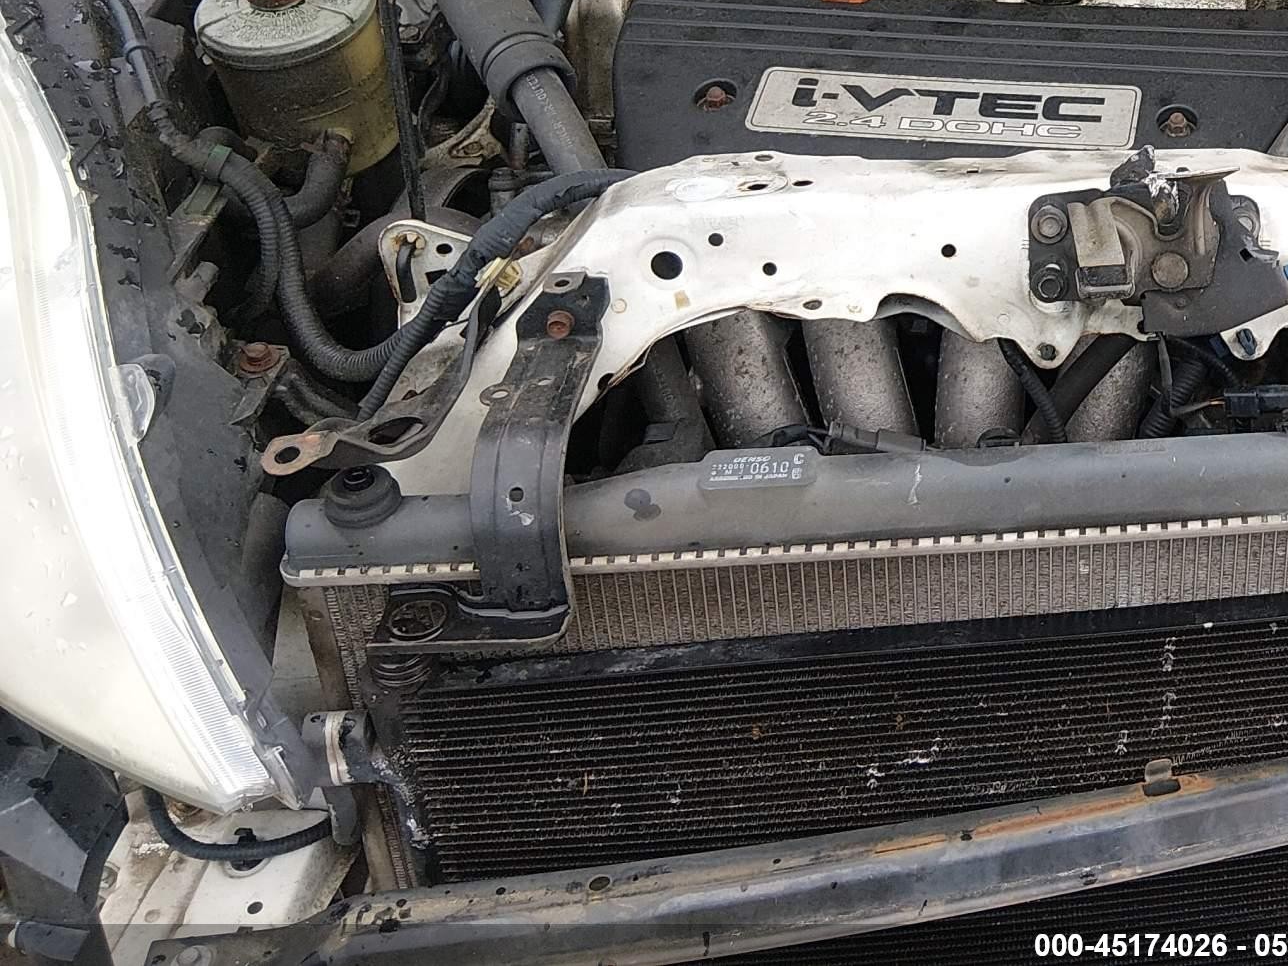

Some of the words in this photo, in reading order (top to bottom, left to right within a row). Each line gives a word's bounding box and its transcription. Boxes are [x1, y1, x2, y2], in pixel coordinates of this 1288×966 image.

[791, 77, 1106, 123] i-VTEC
[803, 110, 886, 129] 2.4
[898, 117, 1083, 139] DOHC
[733, 455, 772, 463] DENSO
